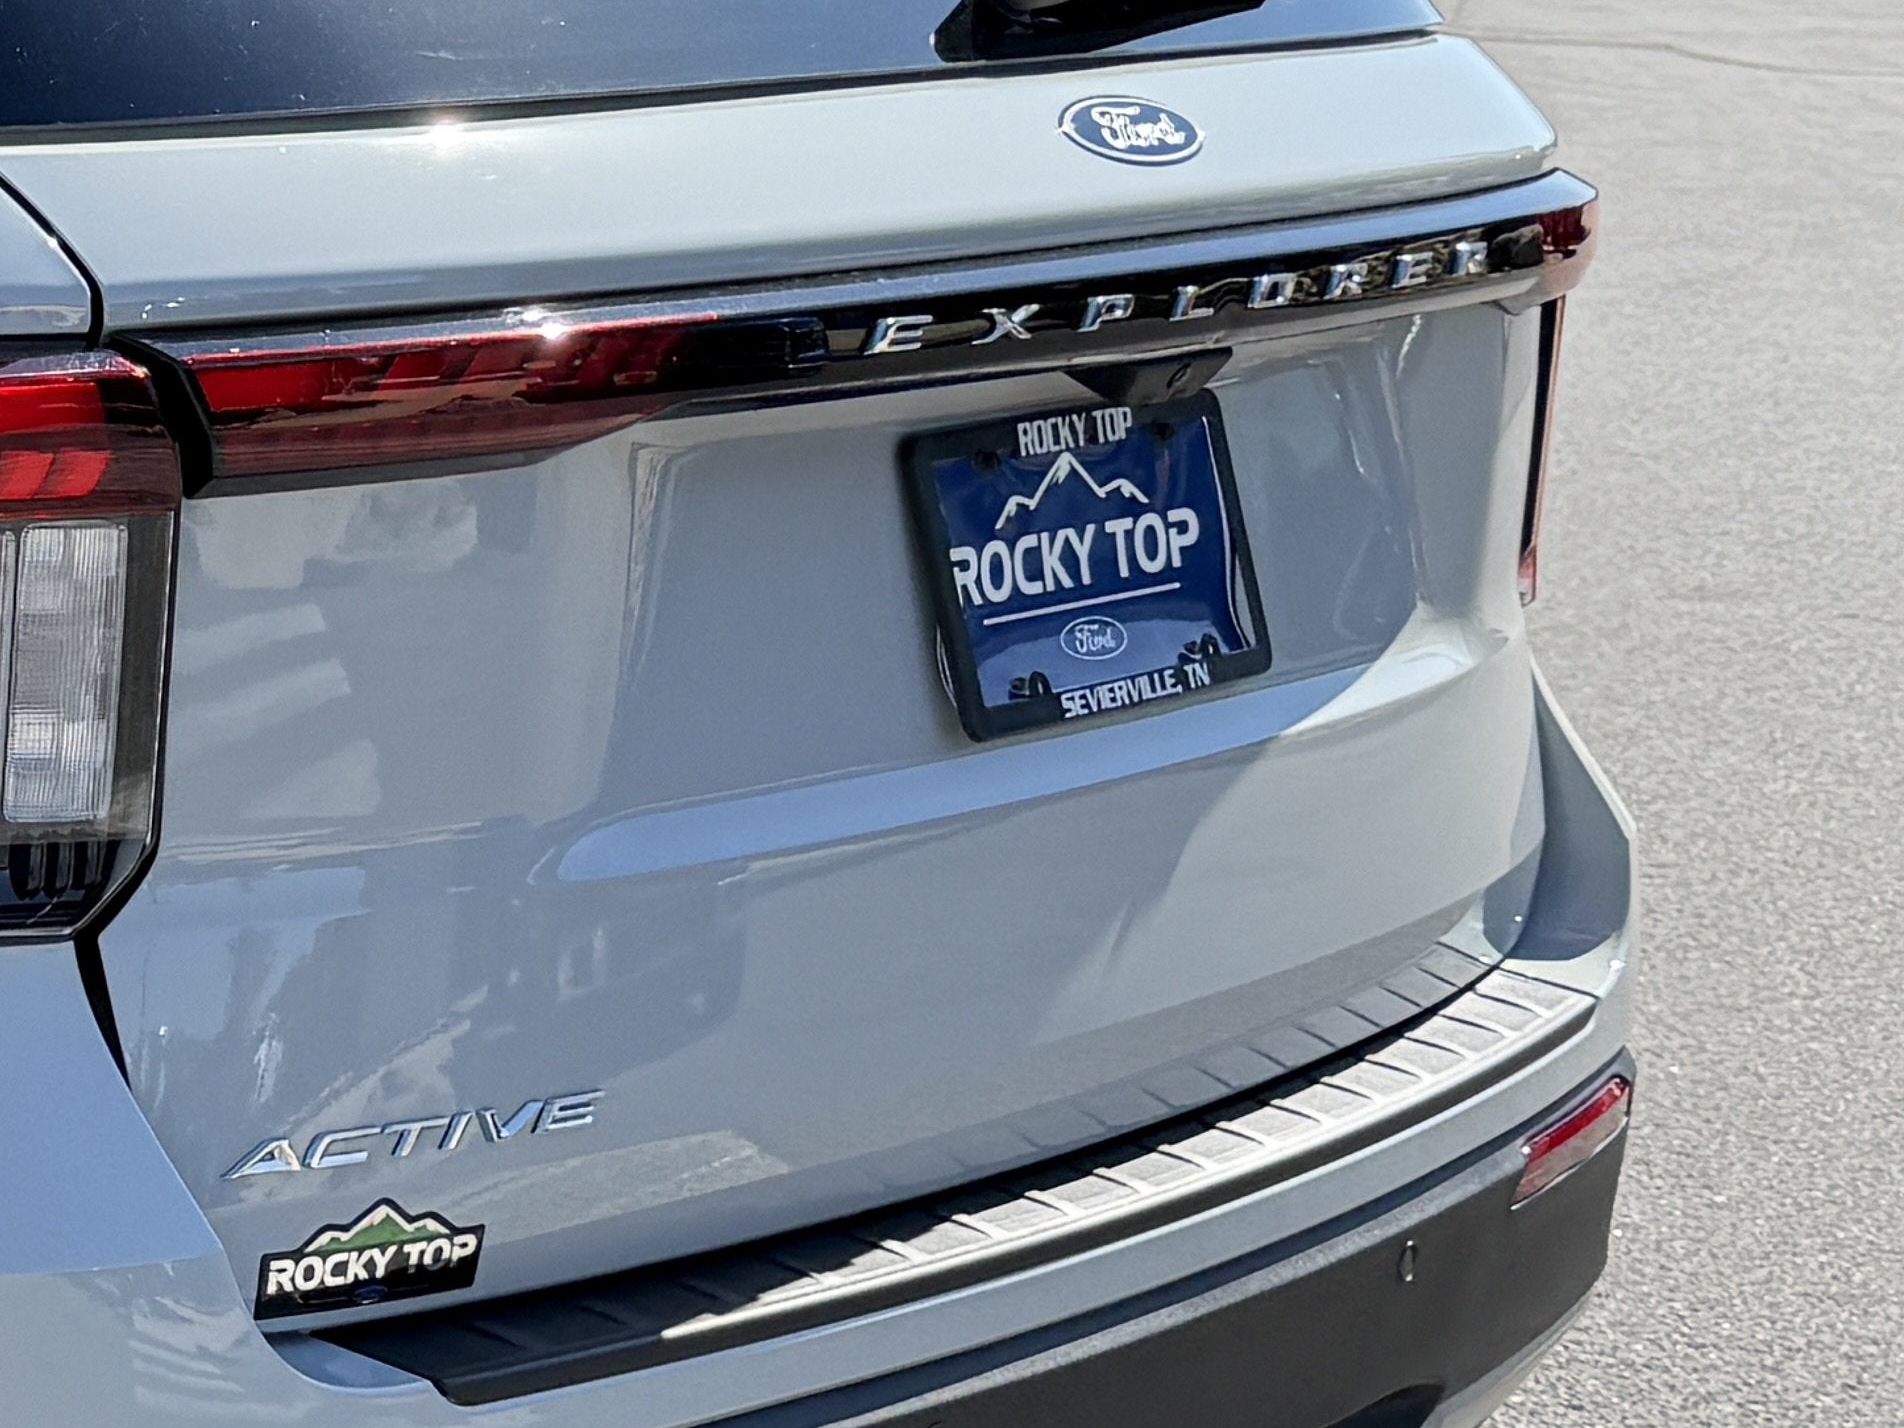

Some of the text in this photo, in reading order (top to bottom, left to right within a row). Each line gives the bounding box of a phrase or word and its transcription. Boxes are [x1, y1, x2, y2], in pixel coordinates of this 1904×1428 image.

[1091, 105, 1186, 150] Ford
[863, 241, 1489, 355] EXPLORER
[1018, 406, 1132, 457] ROCKY TOP
[949, 507, 1200, 606] ROCKY TOP
[1074, 623, 1117, 654] Ford
[1060, 663, 1210, 719] SEVIERVILLE, TN
[221, 1089, 605, 1180] ACTIVE
[266, 1245, 398, 1295] ROCKY
[403, 1234, 478, 1274] TOP
